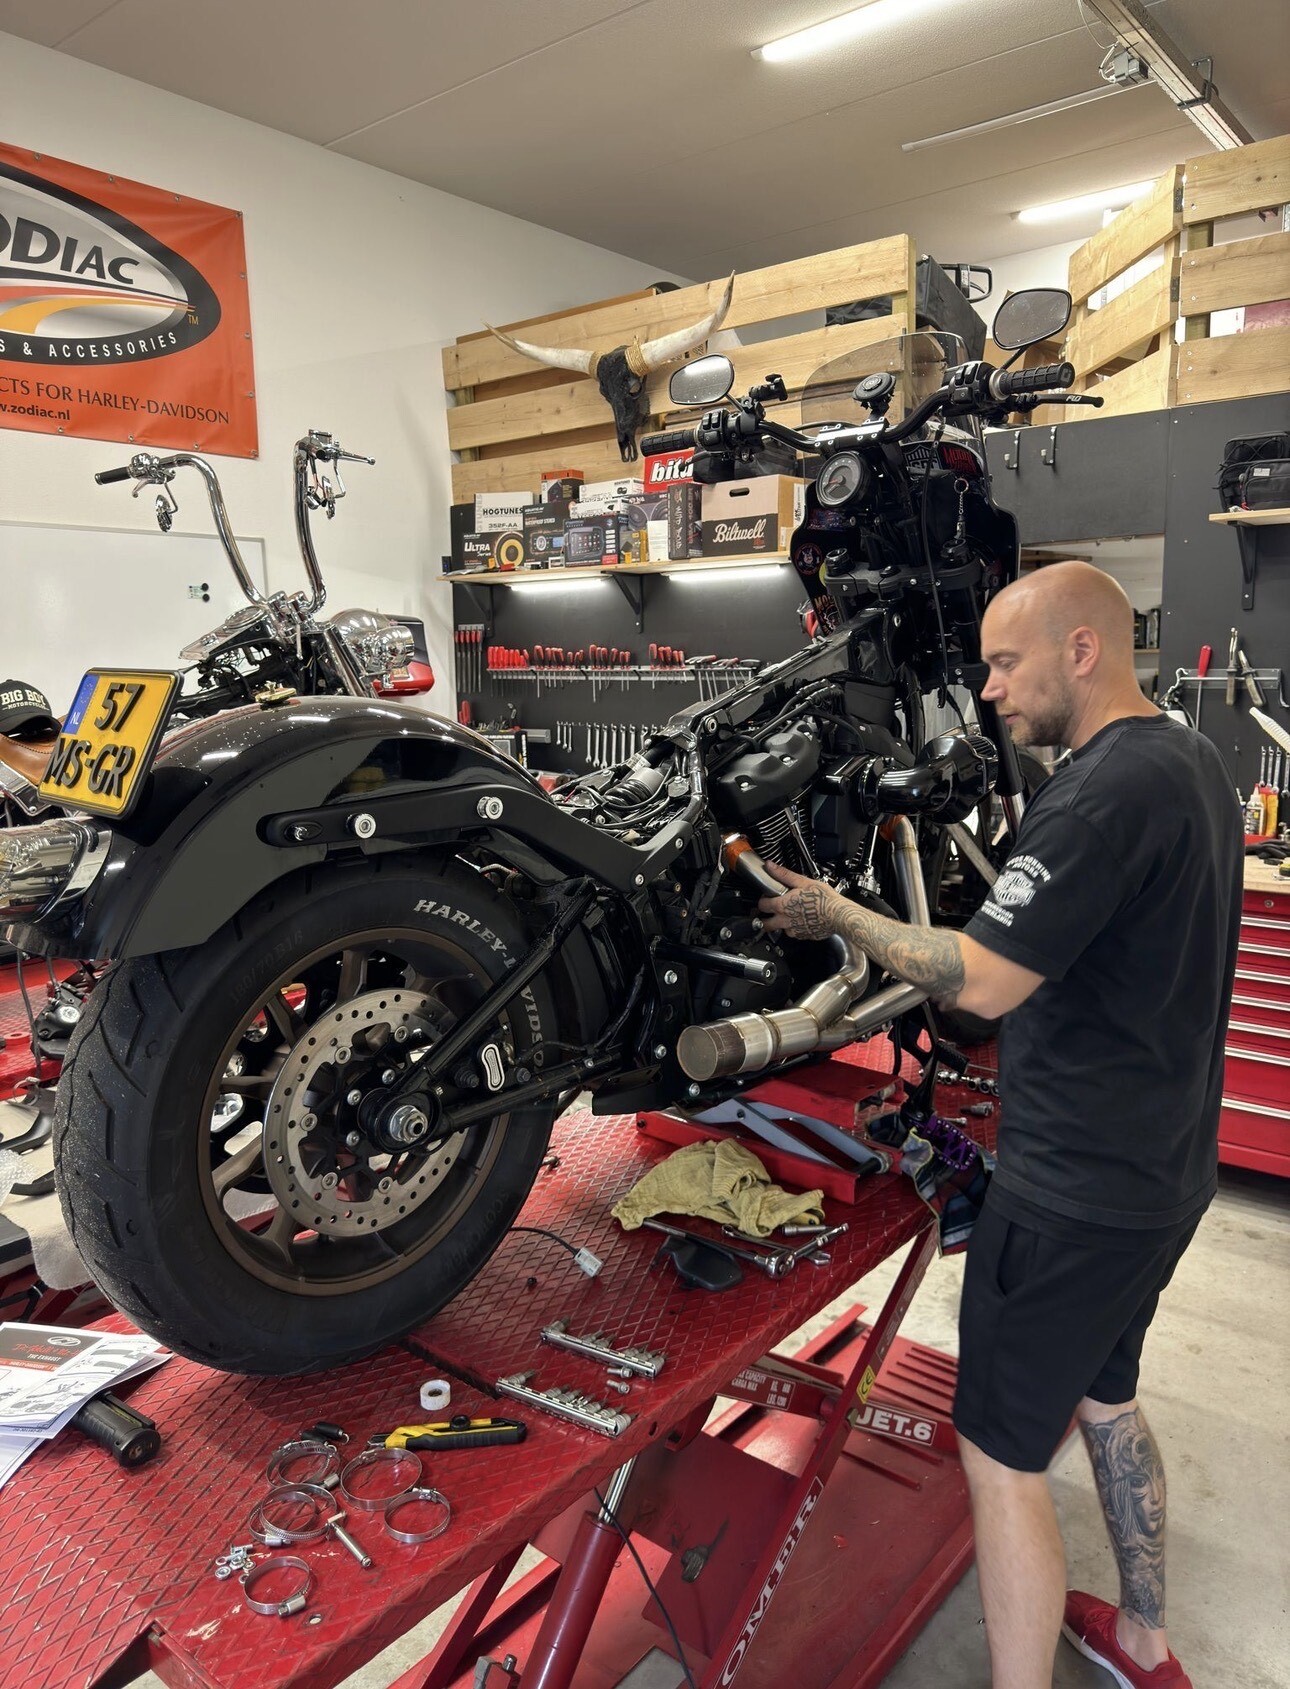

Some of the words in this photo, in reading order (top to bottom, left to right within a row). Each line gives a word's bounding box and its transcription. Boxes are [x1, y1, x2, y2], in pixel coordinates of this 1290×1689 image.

[0, 213, 140, 285] DIAC
[187, 314, 199, 325] TM
[23, 341, 33, 356] &
[49, 331, 177, 358] ACCESSORIES
[36, 382, 73, 401] FOR
[78, 388, 229, 424] HARLEY-DAVIDSON
[482, 507, 523, 516] HOGTUNES
[712, 519, 767, 543] Biltwell
[0, 689, 24, 706] BIG
[25, 689, 46, 706] BOY
[94, 682, 146, 732] 57
[70, 711, 81, 725] NL
[42, 738, 136, 799] MS-GR
[856, 1407, 933, 1442] JET.6
[722, 1494, 817, 1687] OMER
